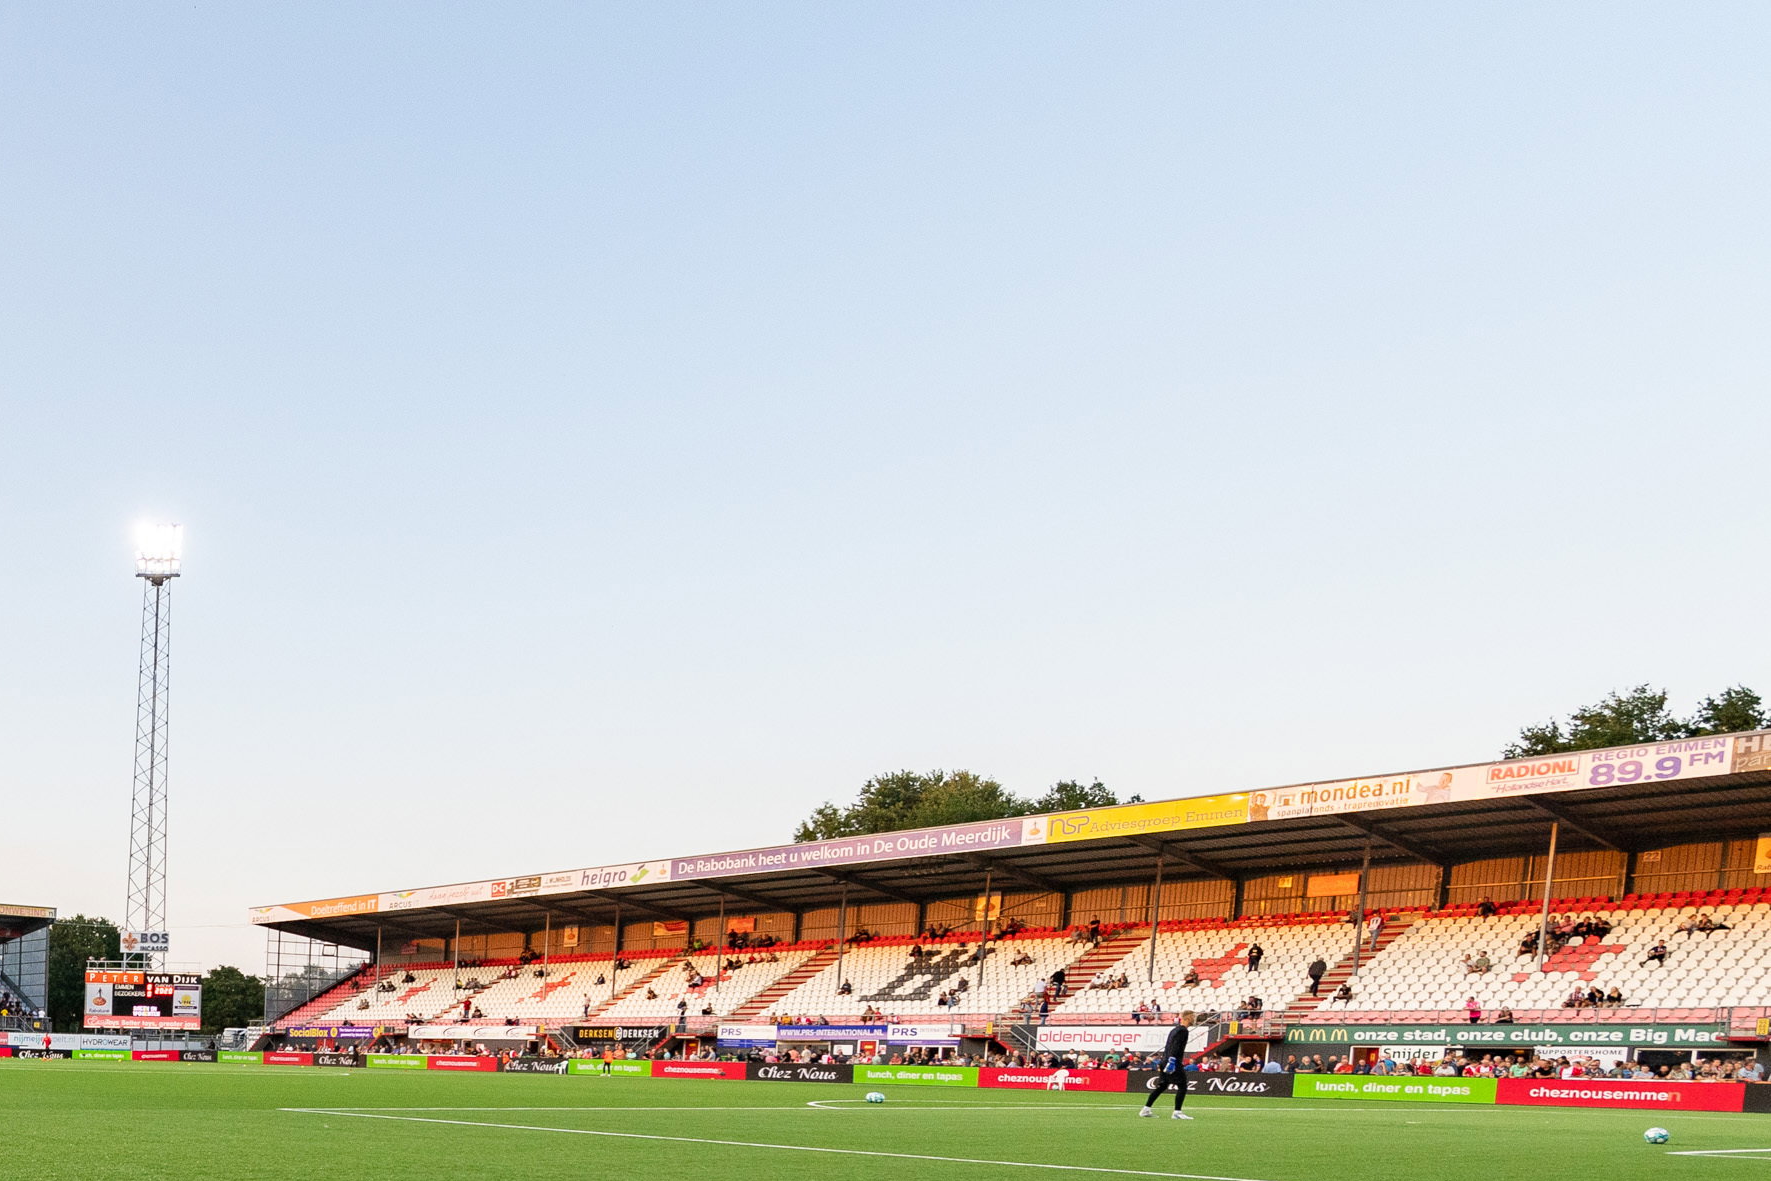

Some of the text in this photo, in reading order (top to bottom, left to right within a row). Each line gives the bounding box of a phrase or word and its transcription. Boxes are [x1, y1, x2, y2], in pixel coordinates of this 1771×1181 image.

[1592, 738, 1726, 762] REGIO EMMEN
[1490, 760, 1576, 780] RADIONL
[1589, 751, 1725, 785] 89.9 FM
[1300, 778, 1411, 804] mondea.nl
[1090, 814, 1181, 833] Adviesgroep
[1185, 809, 1244, 823] Emmen
[678, 825, 1011, 875] De Rabobank heet u welkom in De Oude Meerdijk
[581, 870, 627, 889] heigro
[310, 899, 377, 916] Doeltreffend in IT
[389, 901, 412, 909] ARCUS
[140, 932, 169, 944] BOS
[89, 973, 139, 983] PETER
[289, 1028, 328, 1037] SocialBlox
[579, 1029, 613, 1039] DERKSEN
[623, 1029, 659, 1038] DERKSEN
[892, 1027, 917, 1036] PRS
[1039, 1030, 1141, 1046] oldenburger
[1354, 1028, 1725, 1044] onze stad, onze club, onze Big Mac
[83, 1038, 128, 1046] HYDROWEAR
[1383, 1047, 1438, 1063] Snijder
[1537, 1048, 1623, 1056] SUPPORTERSHOME
[758, 1066, 837, 1080] Chez Nous
[867, 1071, 895, 1080] lunch,
[897, 1071, 920, 1080] diner
[936, 1072, 962, 1082] tapas
[1205, 1077, 1270, 1093] Nous
[1315, 1081, 1470, 1097] lunch, diner en tapas
[1529, 1087, 1681, 1102] cheznousemmen
